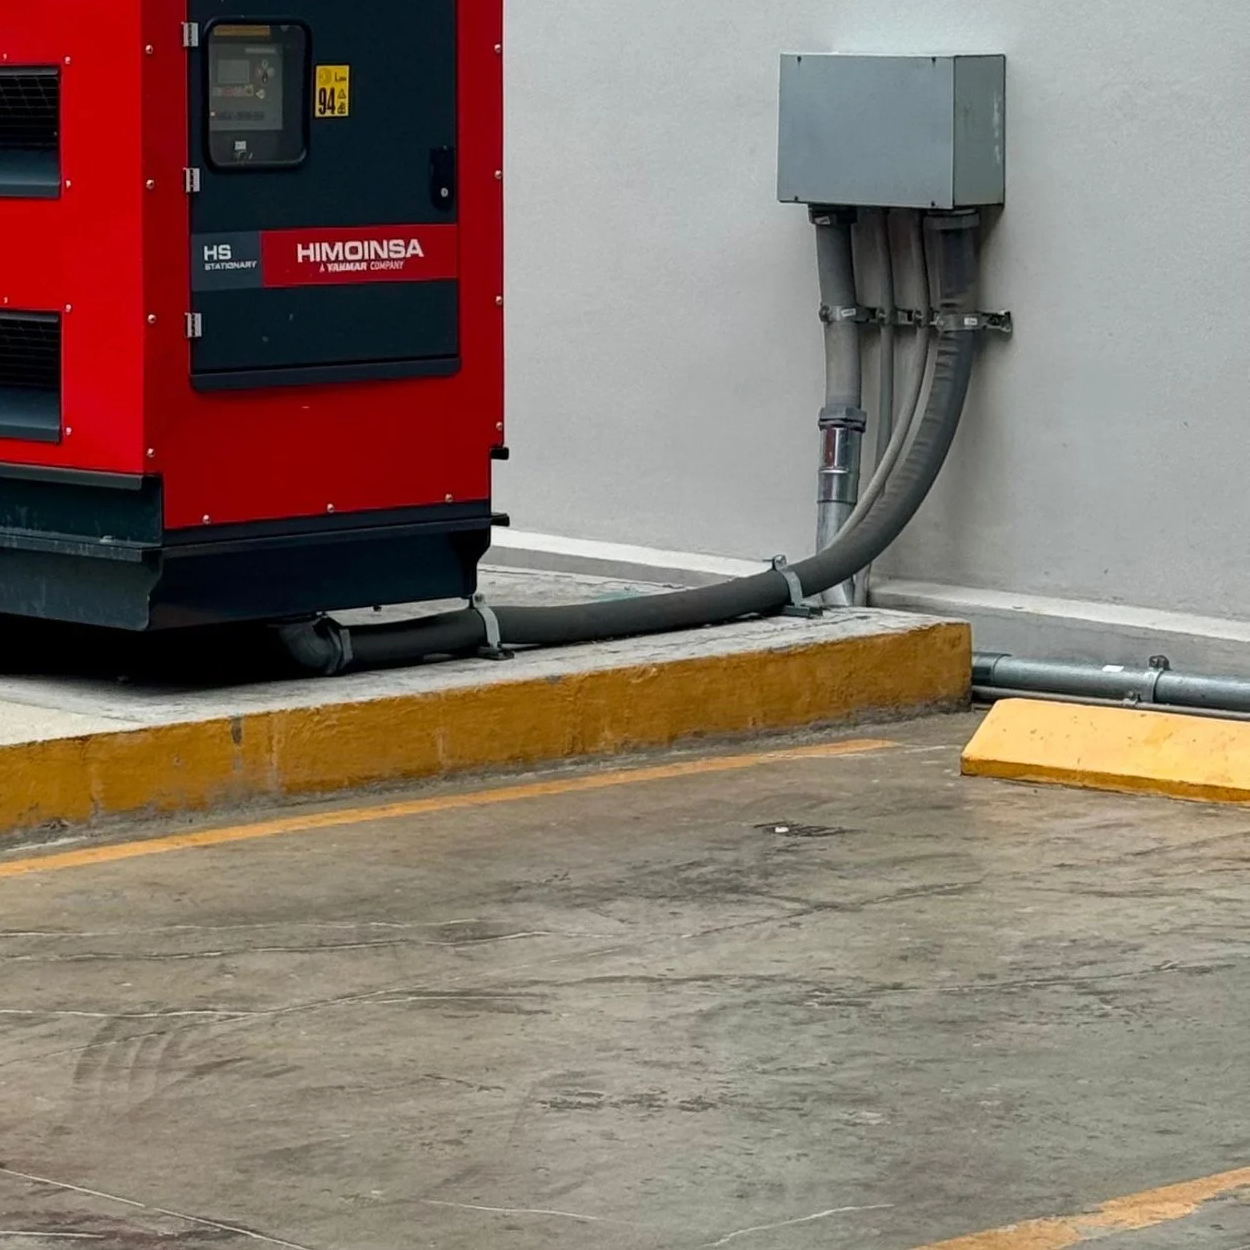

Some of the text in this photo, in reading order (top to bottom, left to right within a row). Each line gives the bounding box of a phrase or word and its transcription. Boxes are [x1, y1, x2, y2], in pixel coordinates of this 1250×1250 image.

[318, 87, 336, 115] 94
[203, 244, 232, 261] HS
[297, 238, 424, 263] HIMOINSA
[204, 260, 257, 271] STATIONARY
[320, 260, 404, 273] A YANMAR COMPANY
